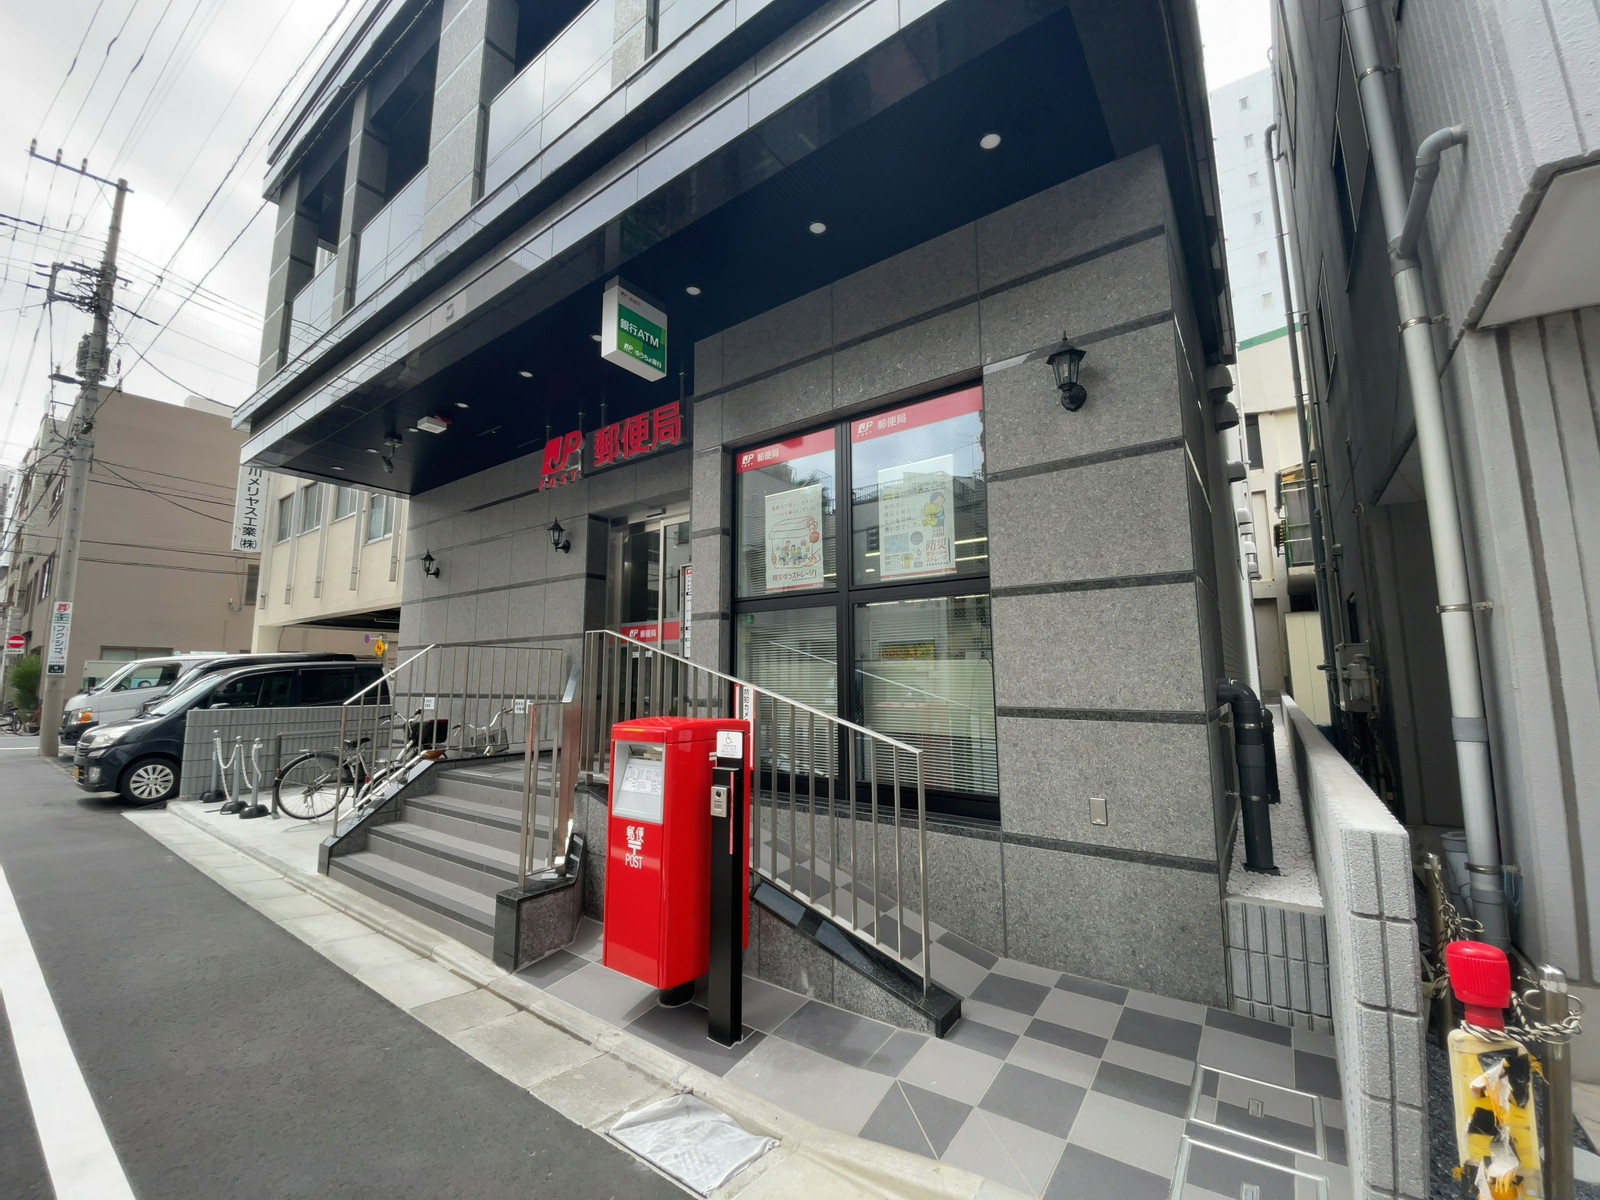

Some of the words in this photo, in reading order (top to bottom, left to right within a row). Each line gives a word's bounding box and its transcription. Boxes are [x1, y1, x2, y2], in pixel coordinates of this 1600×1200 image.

[620, 318, 659, 348] 銀行ATM
[877, 412, 907, 430] 郵便局
[593, 401, 682, 467] 郵便局
[757, 448, 780, 462] 郵便局
[538, 469, 578, 492] POST
[925, 537, 947, 551] 防災
[772, 569, 815, 582] 防災ゆうストレージ
[54, 625, 66, 655] フクシマ
[626, 825, 645, 843] 郵便
[624, 853, 643, 870] POST
